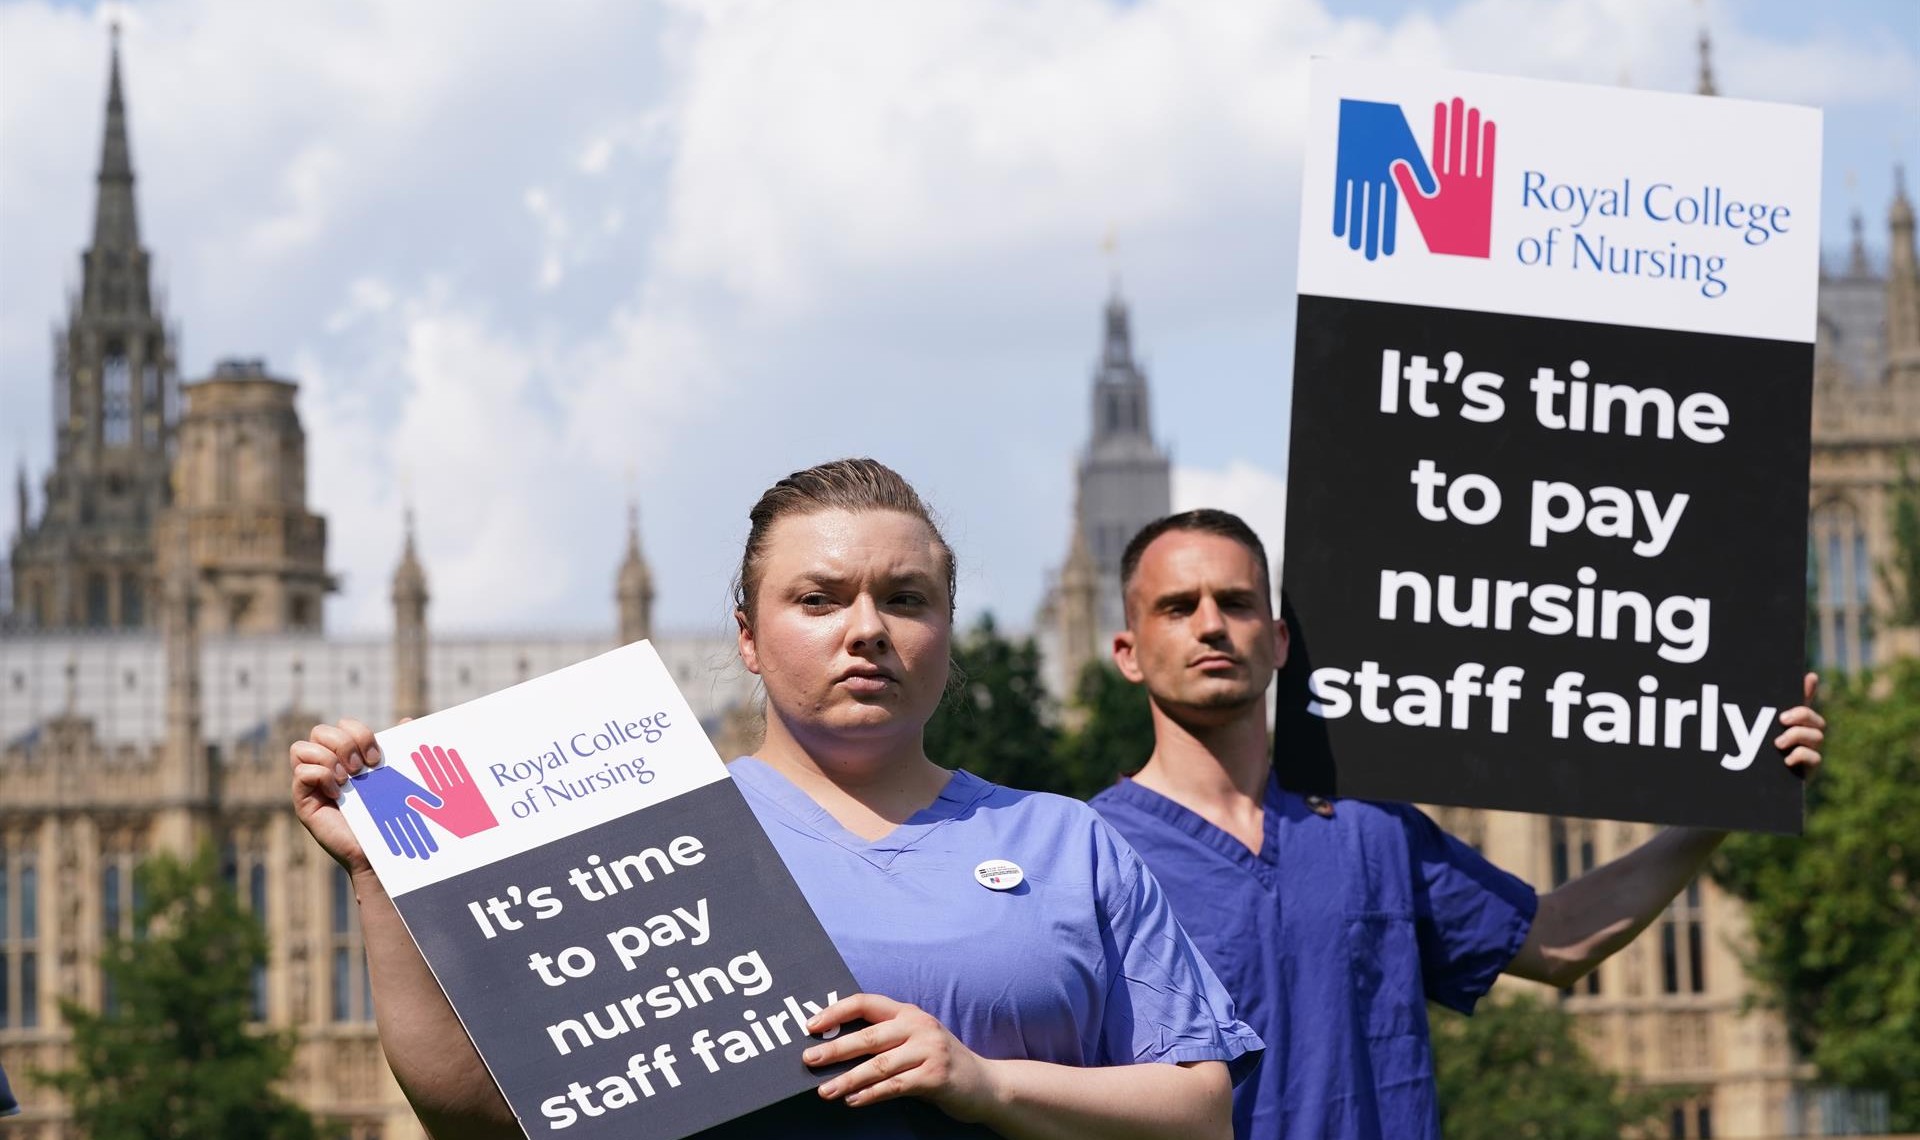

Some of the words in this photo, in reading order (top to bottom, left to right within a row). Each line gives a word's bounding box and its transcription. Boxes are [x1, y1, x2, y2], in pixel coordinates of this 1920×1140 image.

[1522, 171, 1630, 227] Royal
[1644, 183, 1791, 245] College
[1517, 228, 1562, 266] of
[1572, 235, 1728, 298] Nursing
[1530, 360, 1729, 445] time
[1411, 460, 1502, 525] to
[1530, 480, 1690, 557] pay
[1379, 566, 1711, 663] nursing
[489, 741, 568, 788] Royal
[570, 709, 672, 754] College
[1307, 661, 1525, 734] staff
[1546, 672, 1777, 771] fairly
[511, 783, 543, 819] of
[542, 756, 655, 808] Nursing
[568, 835, 706, 903] time
[528, 946, 595, 987] to
[606, 898, 710, 971] pay
[546, 950, 772, 1055] nursing
[540, 1050, 682, 1130] staff
